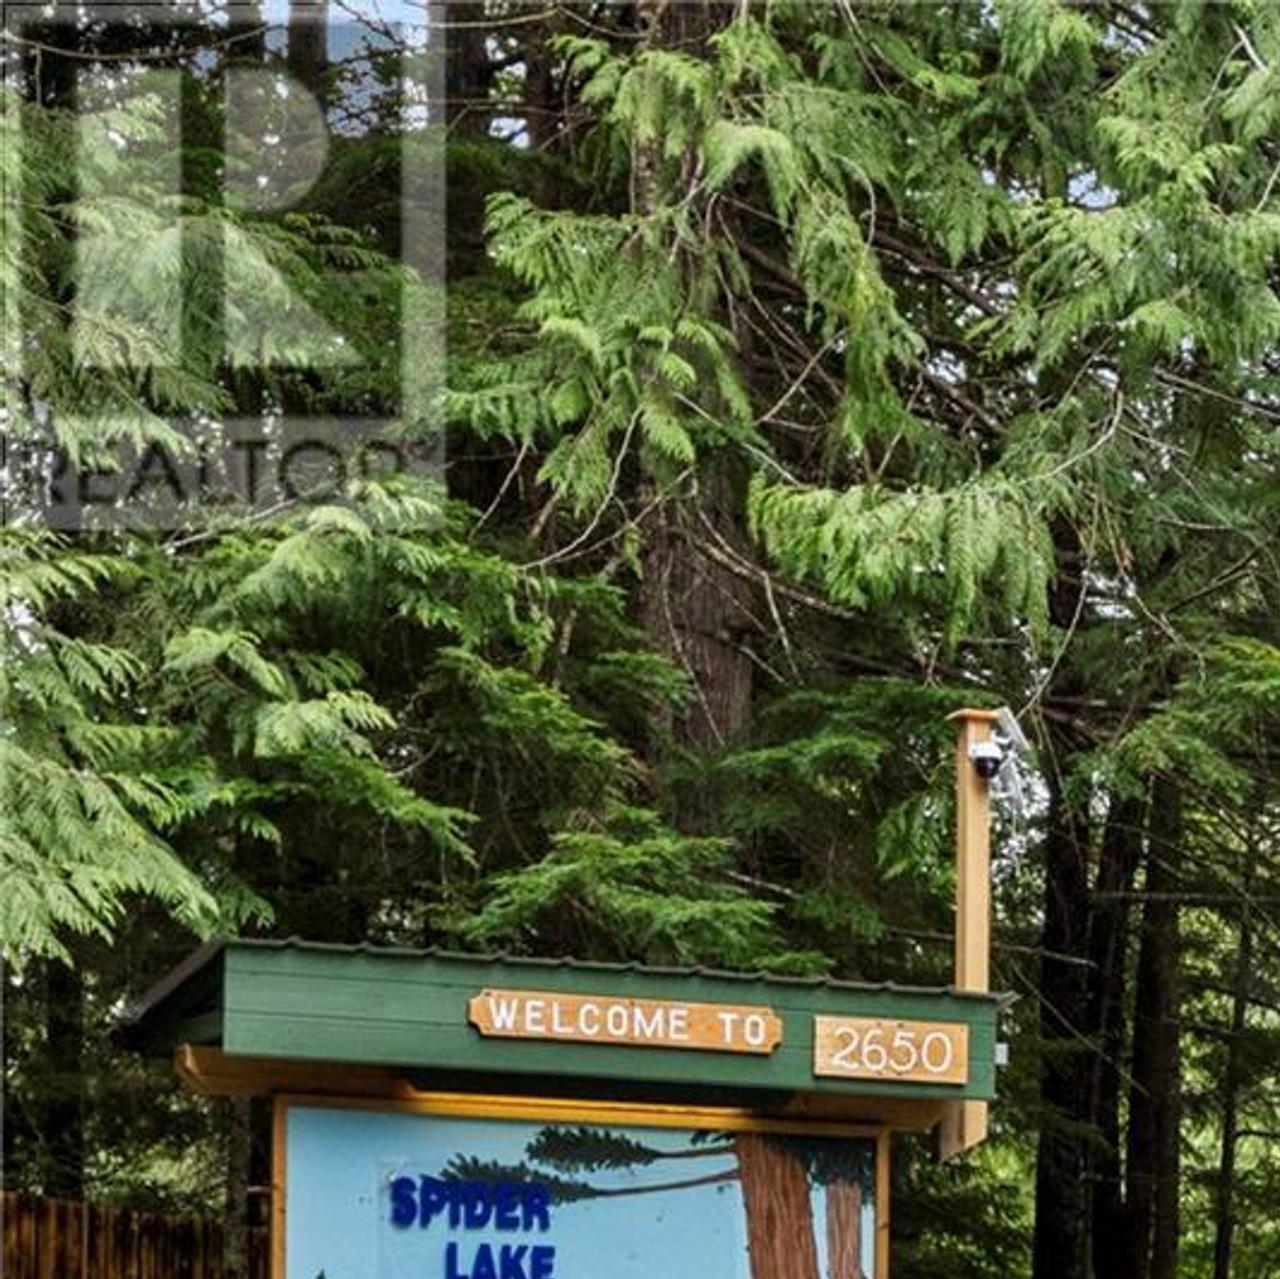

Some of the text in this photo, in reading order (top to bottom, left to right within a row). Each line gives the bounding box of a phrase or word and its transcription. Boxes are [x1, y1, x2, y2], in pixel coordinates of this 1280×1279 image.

[489, 997, 767, 1046] WELCOME TO
[831, 1025, 954, 1074] 2650
[388, 1175, 551, 1231] SPIDER
